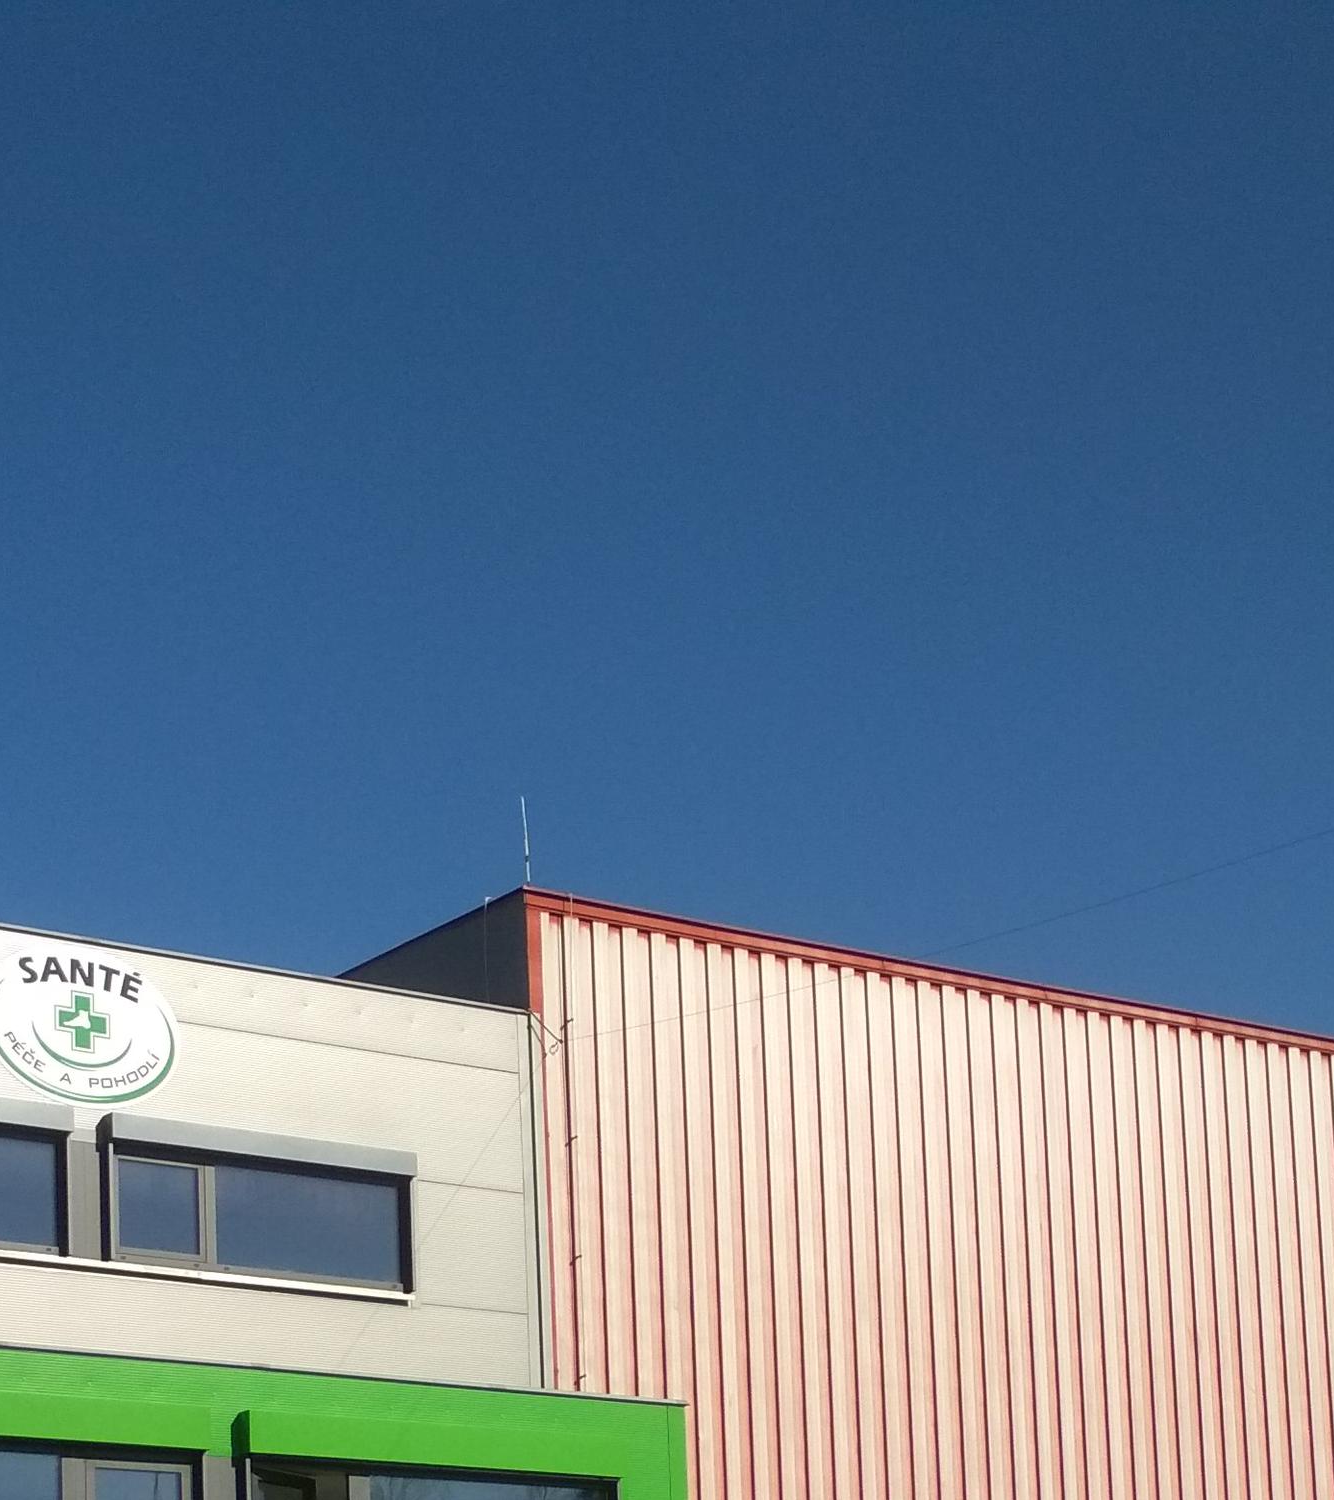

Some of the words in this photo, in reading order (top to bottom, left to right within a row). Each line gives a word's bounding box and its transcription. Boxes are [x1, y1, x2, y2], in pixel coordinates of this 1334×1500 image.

[18, 956, 143, 1004] SANTÉ
[4, 1031, 47, 1073] PÉČE
[59, 1073, 72, 1085] A
[88, 1048, 160, 1089] POHODLÍ
